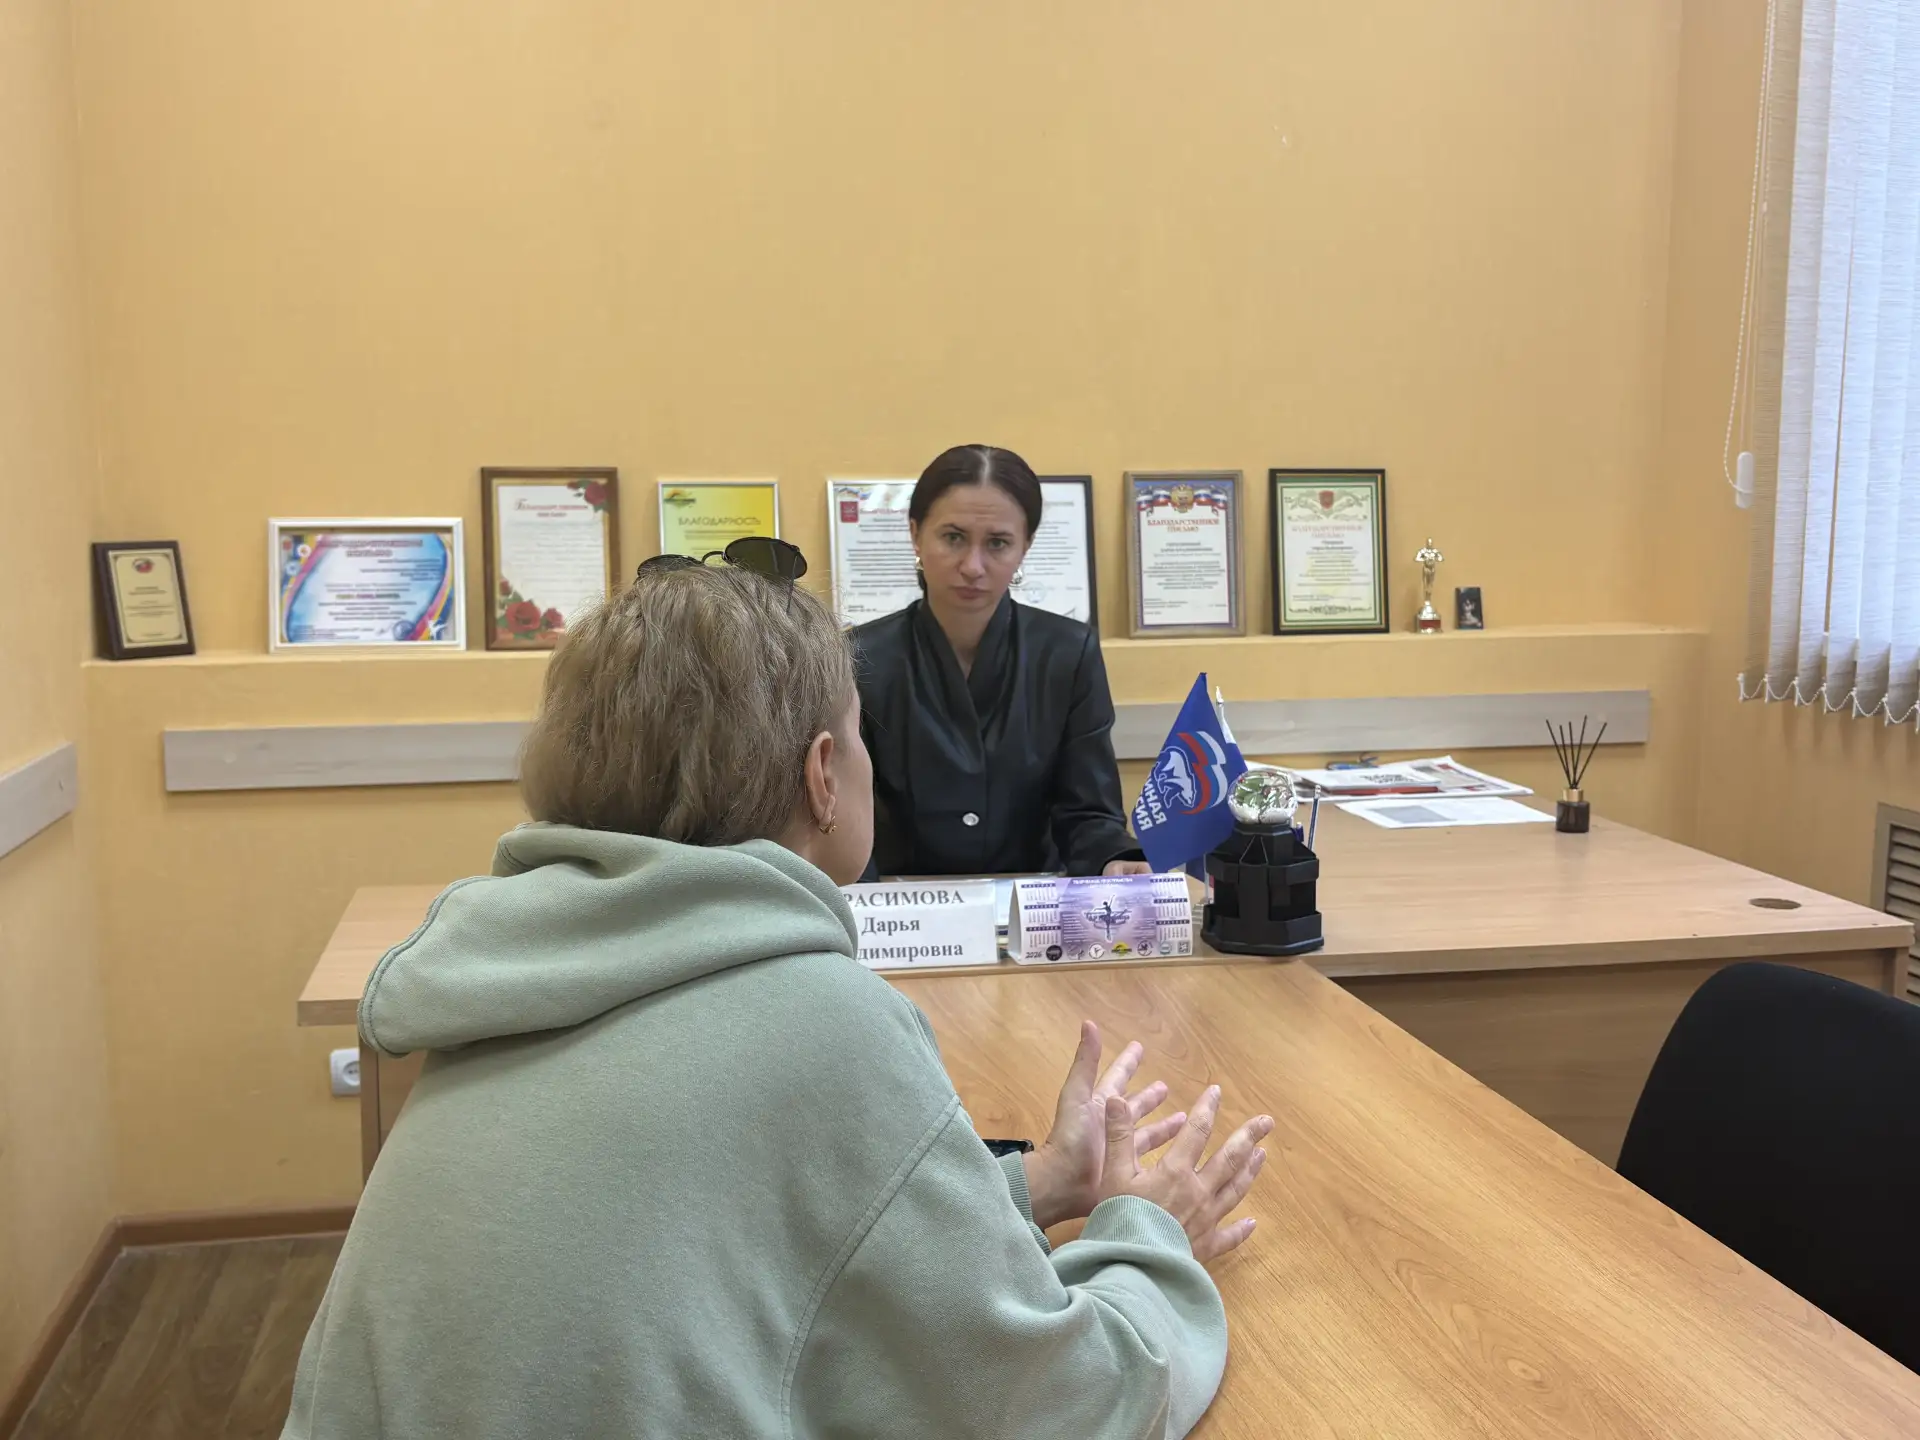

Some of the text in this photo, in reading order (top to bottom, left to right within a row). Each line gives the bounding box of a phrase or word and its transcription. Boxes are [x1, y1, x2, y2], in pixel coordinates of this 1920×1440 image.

[677, 516, 762, 526] БЛАГОДАРНОСТЬ
[1144, 777, 1168, 825] ИНАЯ
[843, 890, 965, 908] РАСИМОВА
[861, 917, 920, 936] Дарья
[857, 944, 964, 962] димировна
